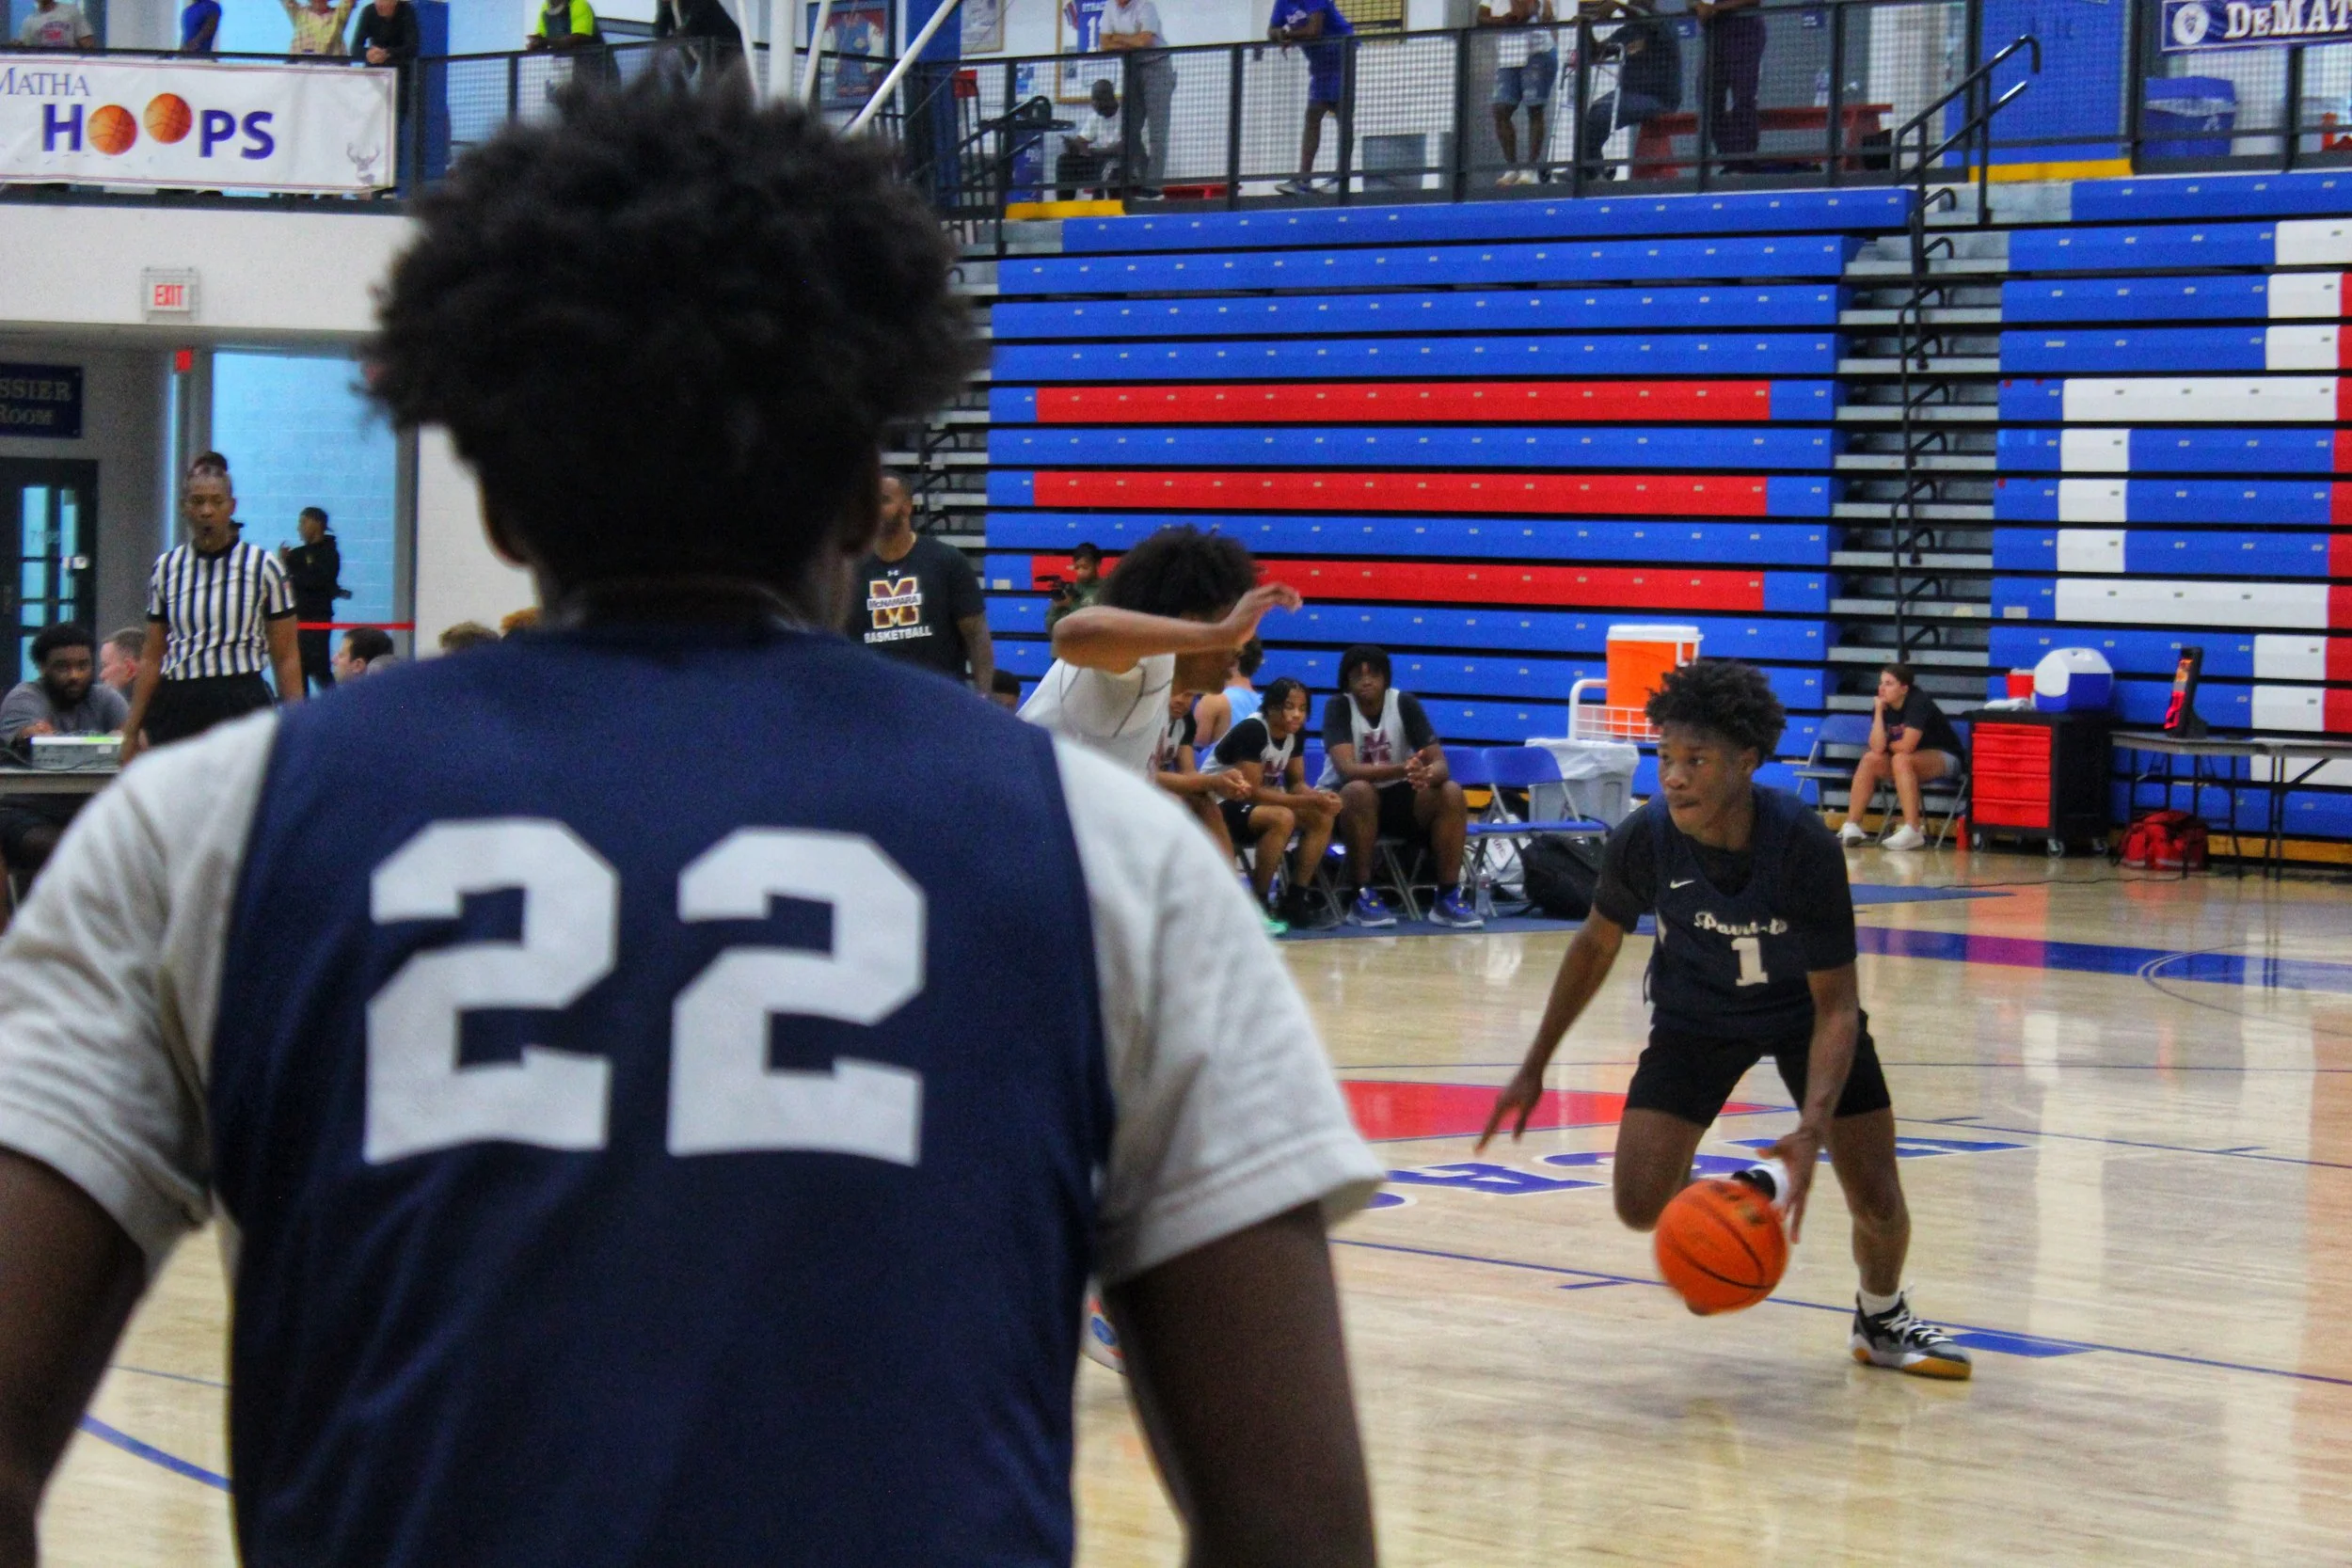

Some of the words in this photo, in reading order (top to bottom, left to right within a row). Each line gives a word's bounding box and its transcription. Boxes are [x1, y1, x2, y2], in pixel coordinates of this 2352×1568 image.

[154, 284, 184, 307] EXIT
[864, 626, 932, 644] BASKETBALL
[1731, 937, 1769, 987] 1
[363, 816, 928, 1167] 22
